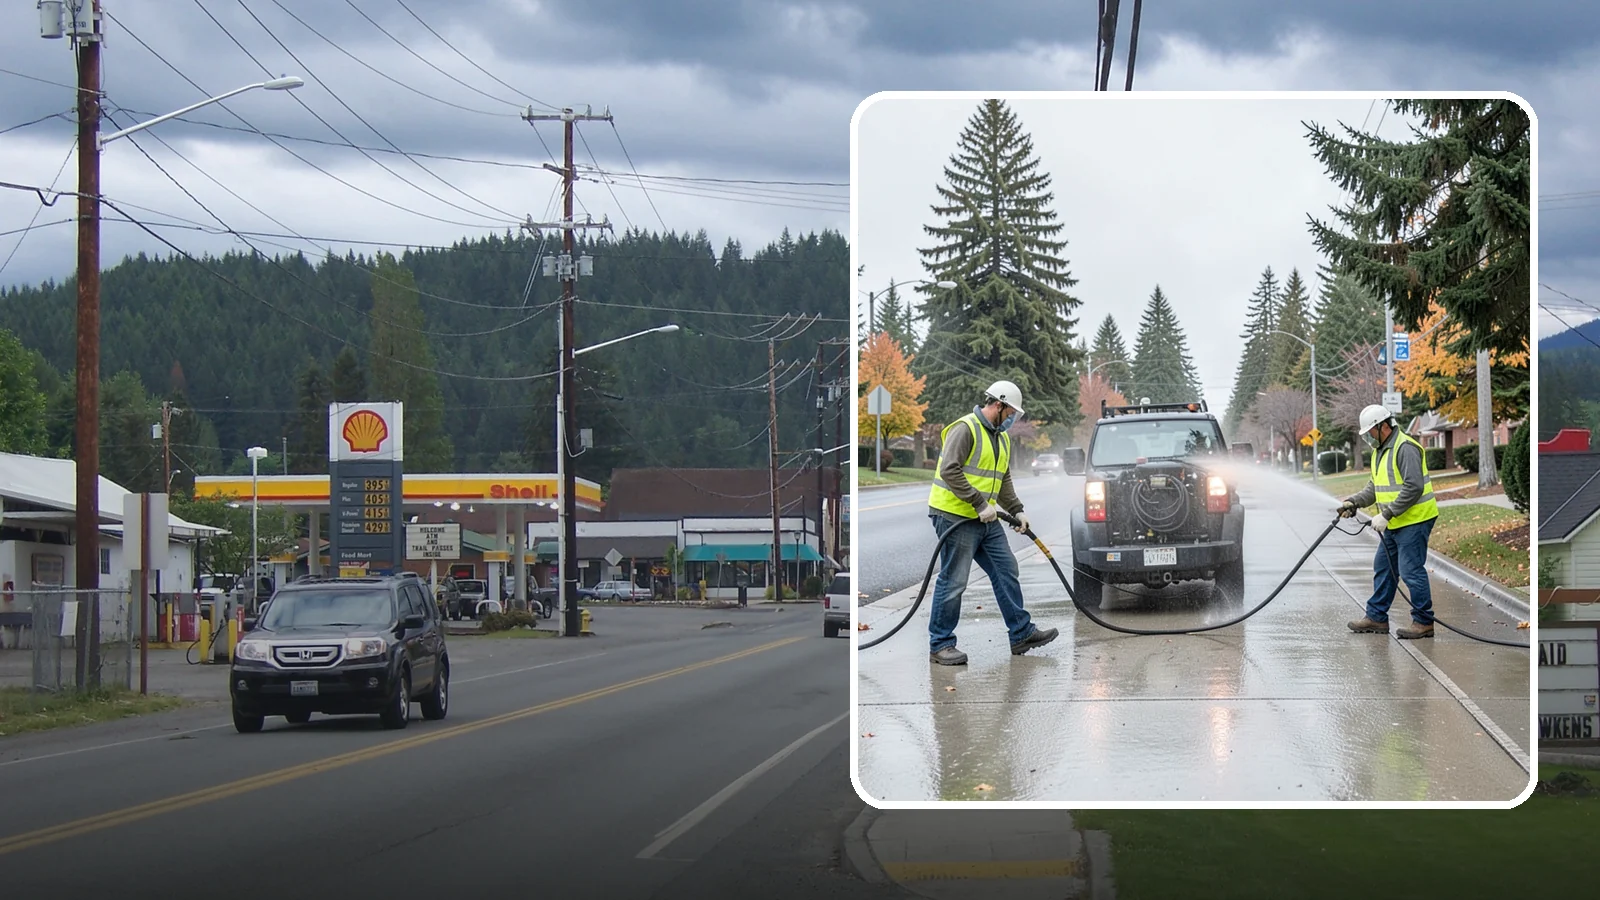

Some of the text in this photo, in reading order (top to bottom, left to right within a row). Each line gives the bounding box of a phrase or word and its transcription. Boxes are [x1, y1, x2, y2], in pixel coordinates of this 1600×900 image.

[365, 480, 383, 490] 395
[490, 484, 548, 499] Shell
[366, 494, 383, 504] 405
[366, 508, 383, 518] 415
[366, 522, 384, 532] 429
